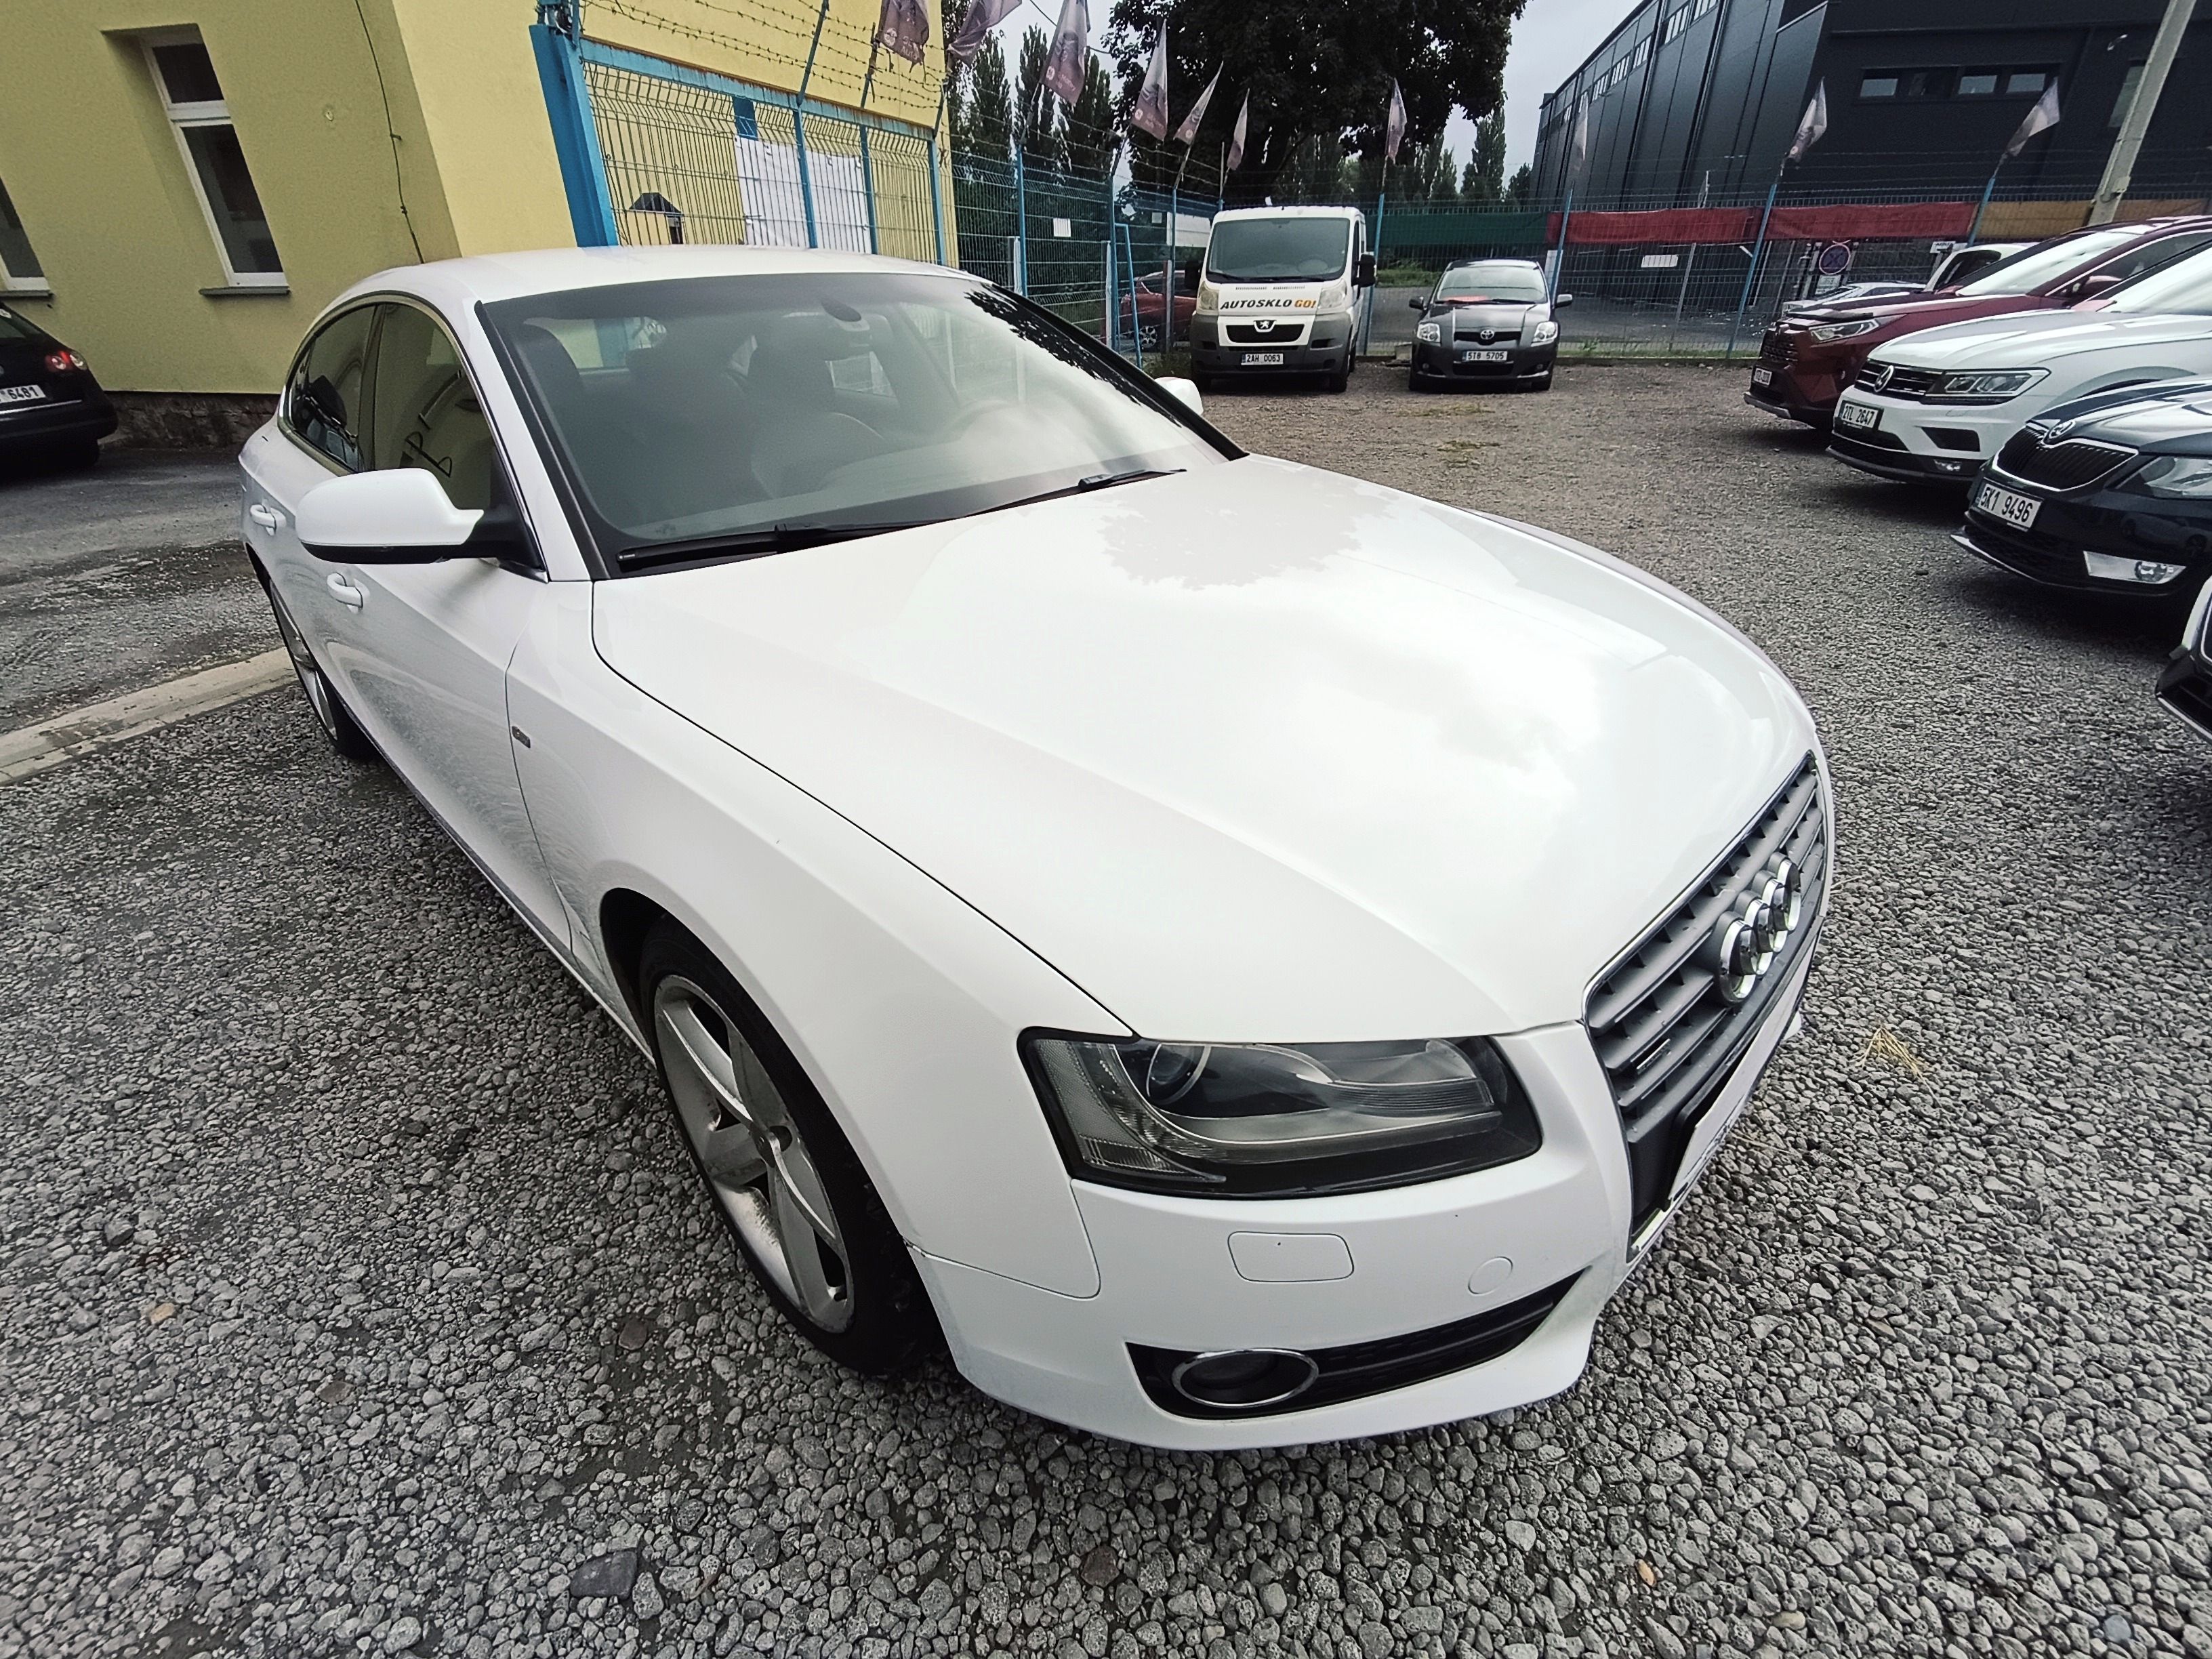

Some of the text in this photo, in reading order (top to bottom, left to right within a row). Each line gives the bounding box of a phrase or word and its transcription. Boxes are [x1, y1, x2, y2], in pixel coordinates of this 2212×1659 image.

[1220, 299, 1317, 310] AUTOSKLO GO!
[1247, 354, 1260, 363] 2AH
[1486, 352, 1504, 360] 5705
[7, 386, 39, 400] 6481
[1856, 409, 1875, 426] 2647
[1980, 487, 2033, 523] 5K1 9496
